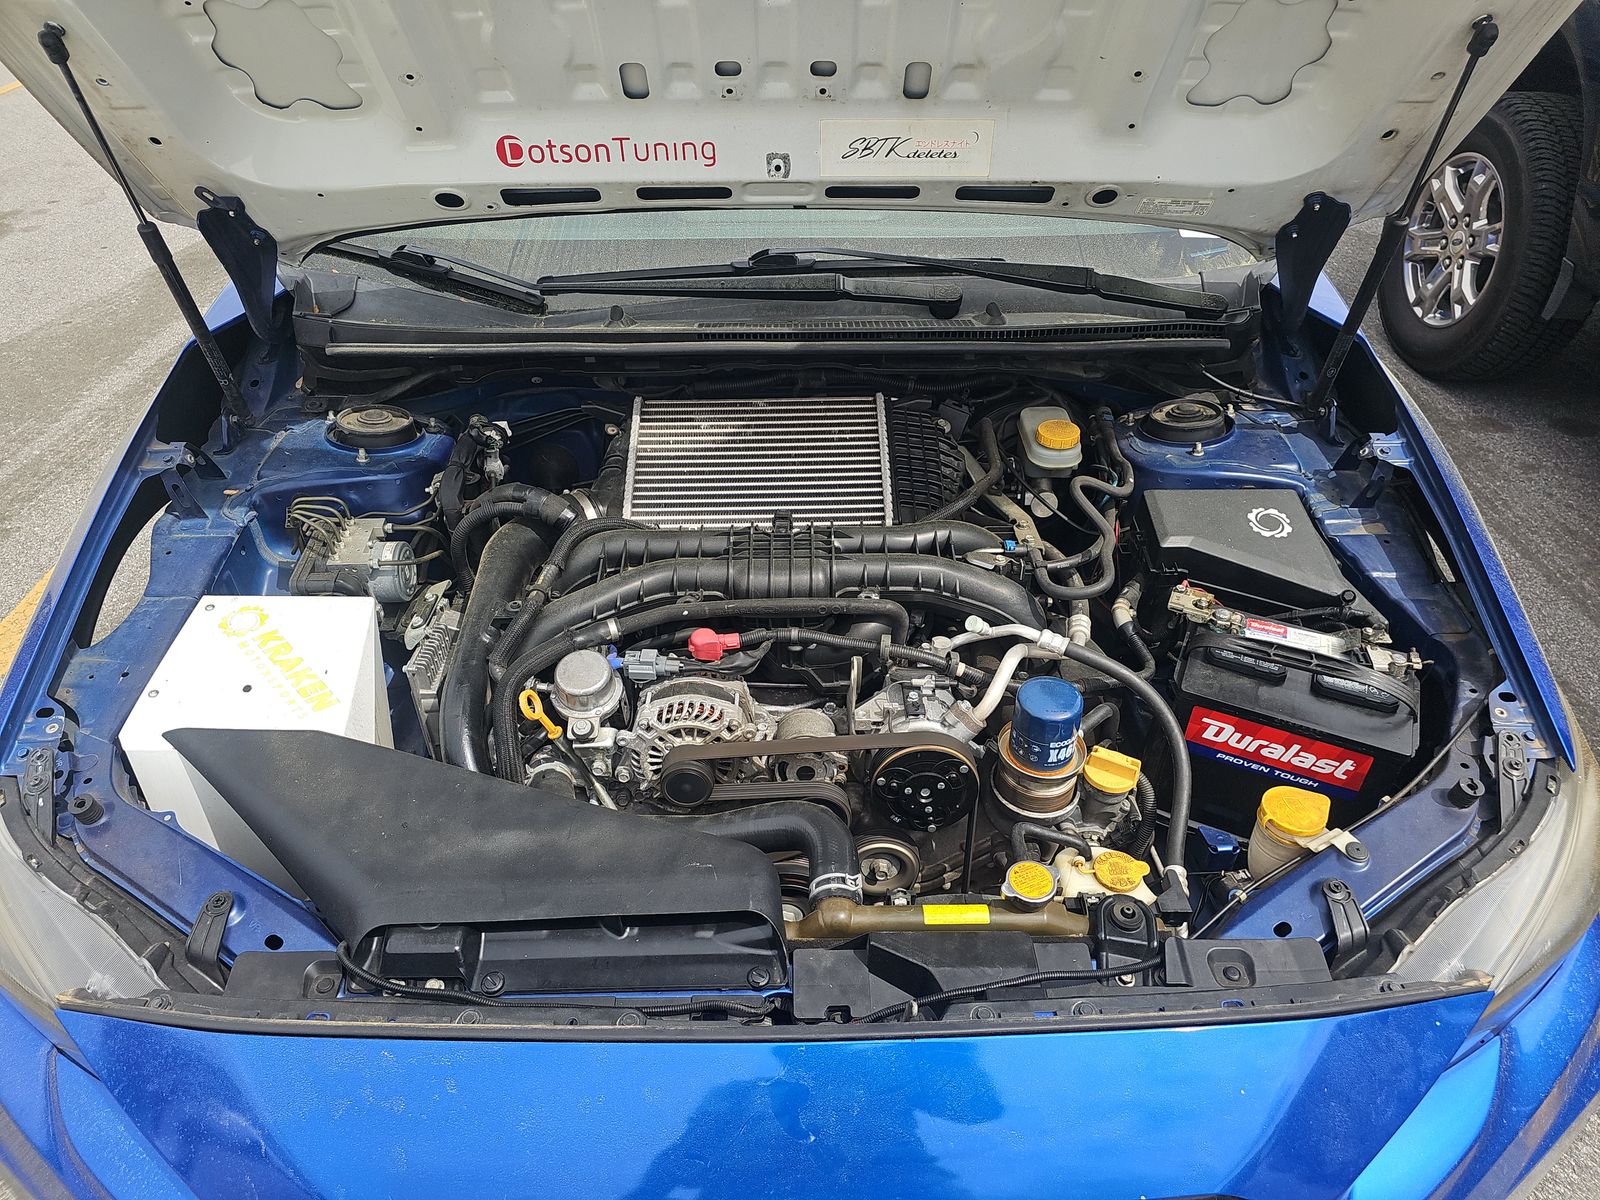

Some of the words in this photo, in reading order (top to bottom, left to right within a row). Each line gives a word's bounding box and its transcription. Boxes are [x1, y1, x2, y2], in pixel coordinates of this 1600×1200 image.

[841, 136, 913, 160] SBTK
[905, 149, 960, 159] deletes
[253, 629, 341, 713] KRAKEN
[1201, 717, 1357, 780] Duralast
[1215, 752, 1269, 773] PROVEN
[1273, 770, 1320, 788] TOUGH
